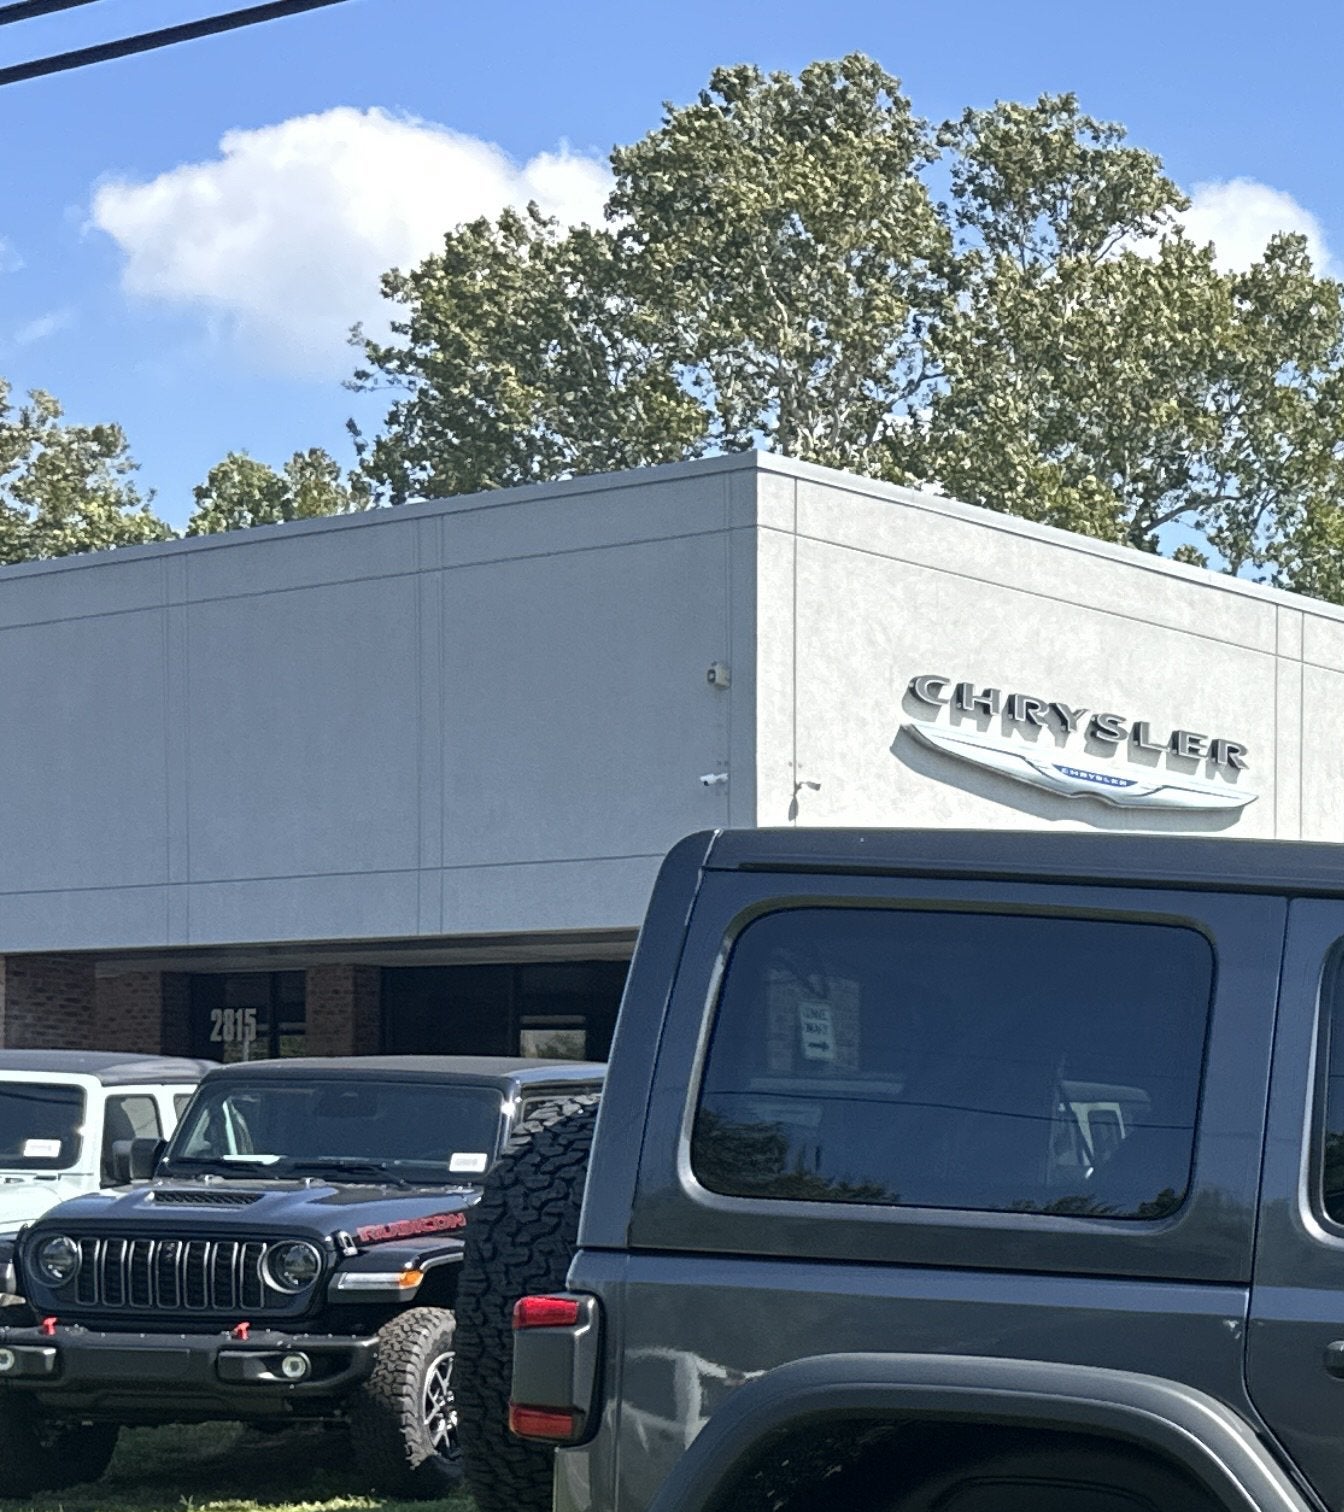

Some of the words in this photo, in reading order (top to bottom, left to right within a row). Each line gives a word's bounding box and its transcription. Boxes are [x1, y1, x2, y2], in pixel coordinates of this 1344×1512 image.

[908, 674, 1250, 770] CHRYSLER
[1061, 767, 1127, 786] CHRYSLER
[210, 1007, 257, 1042] 2815
[357, 1213, 467, 1242] RUBICON
